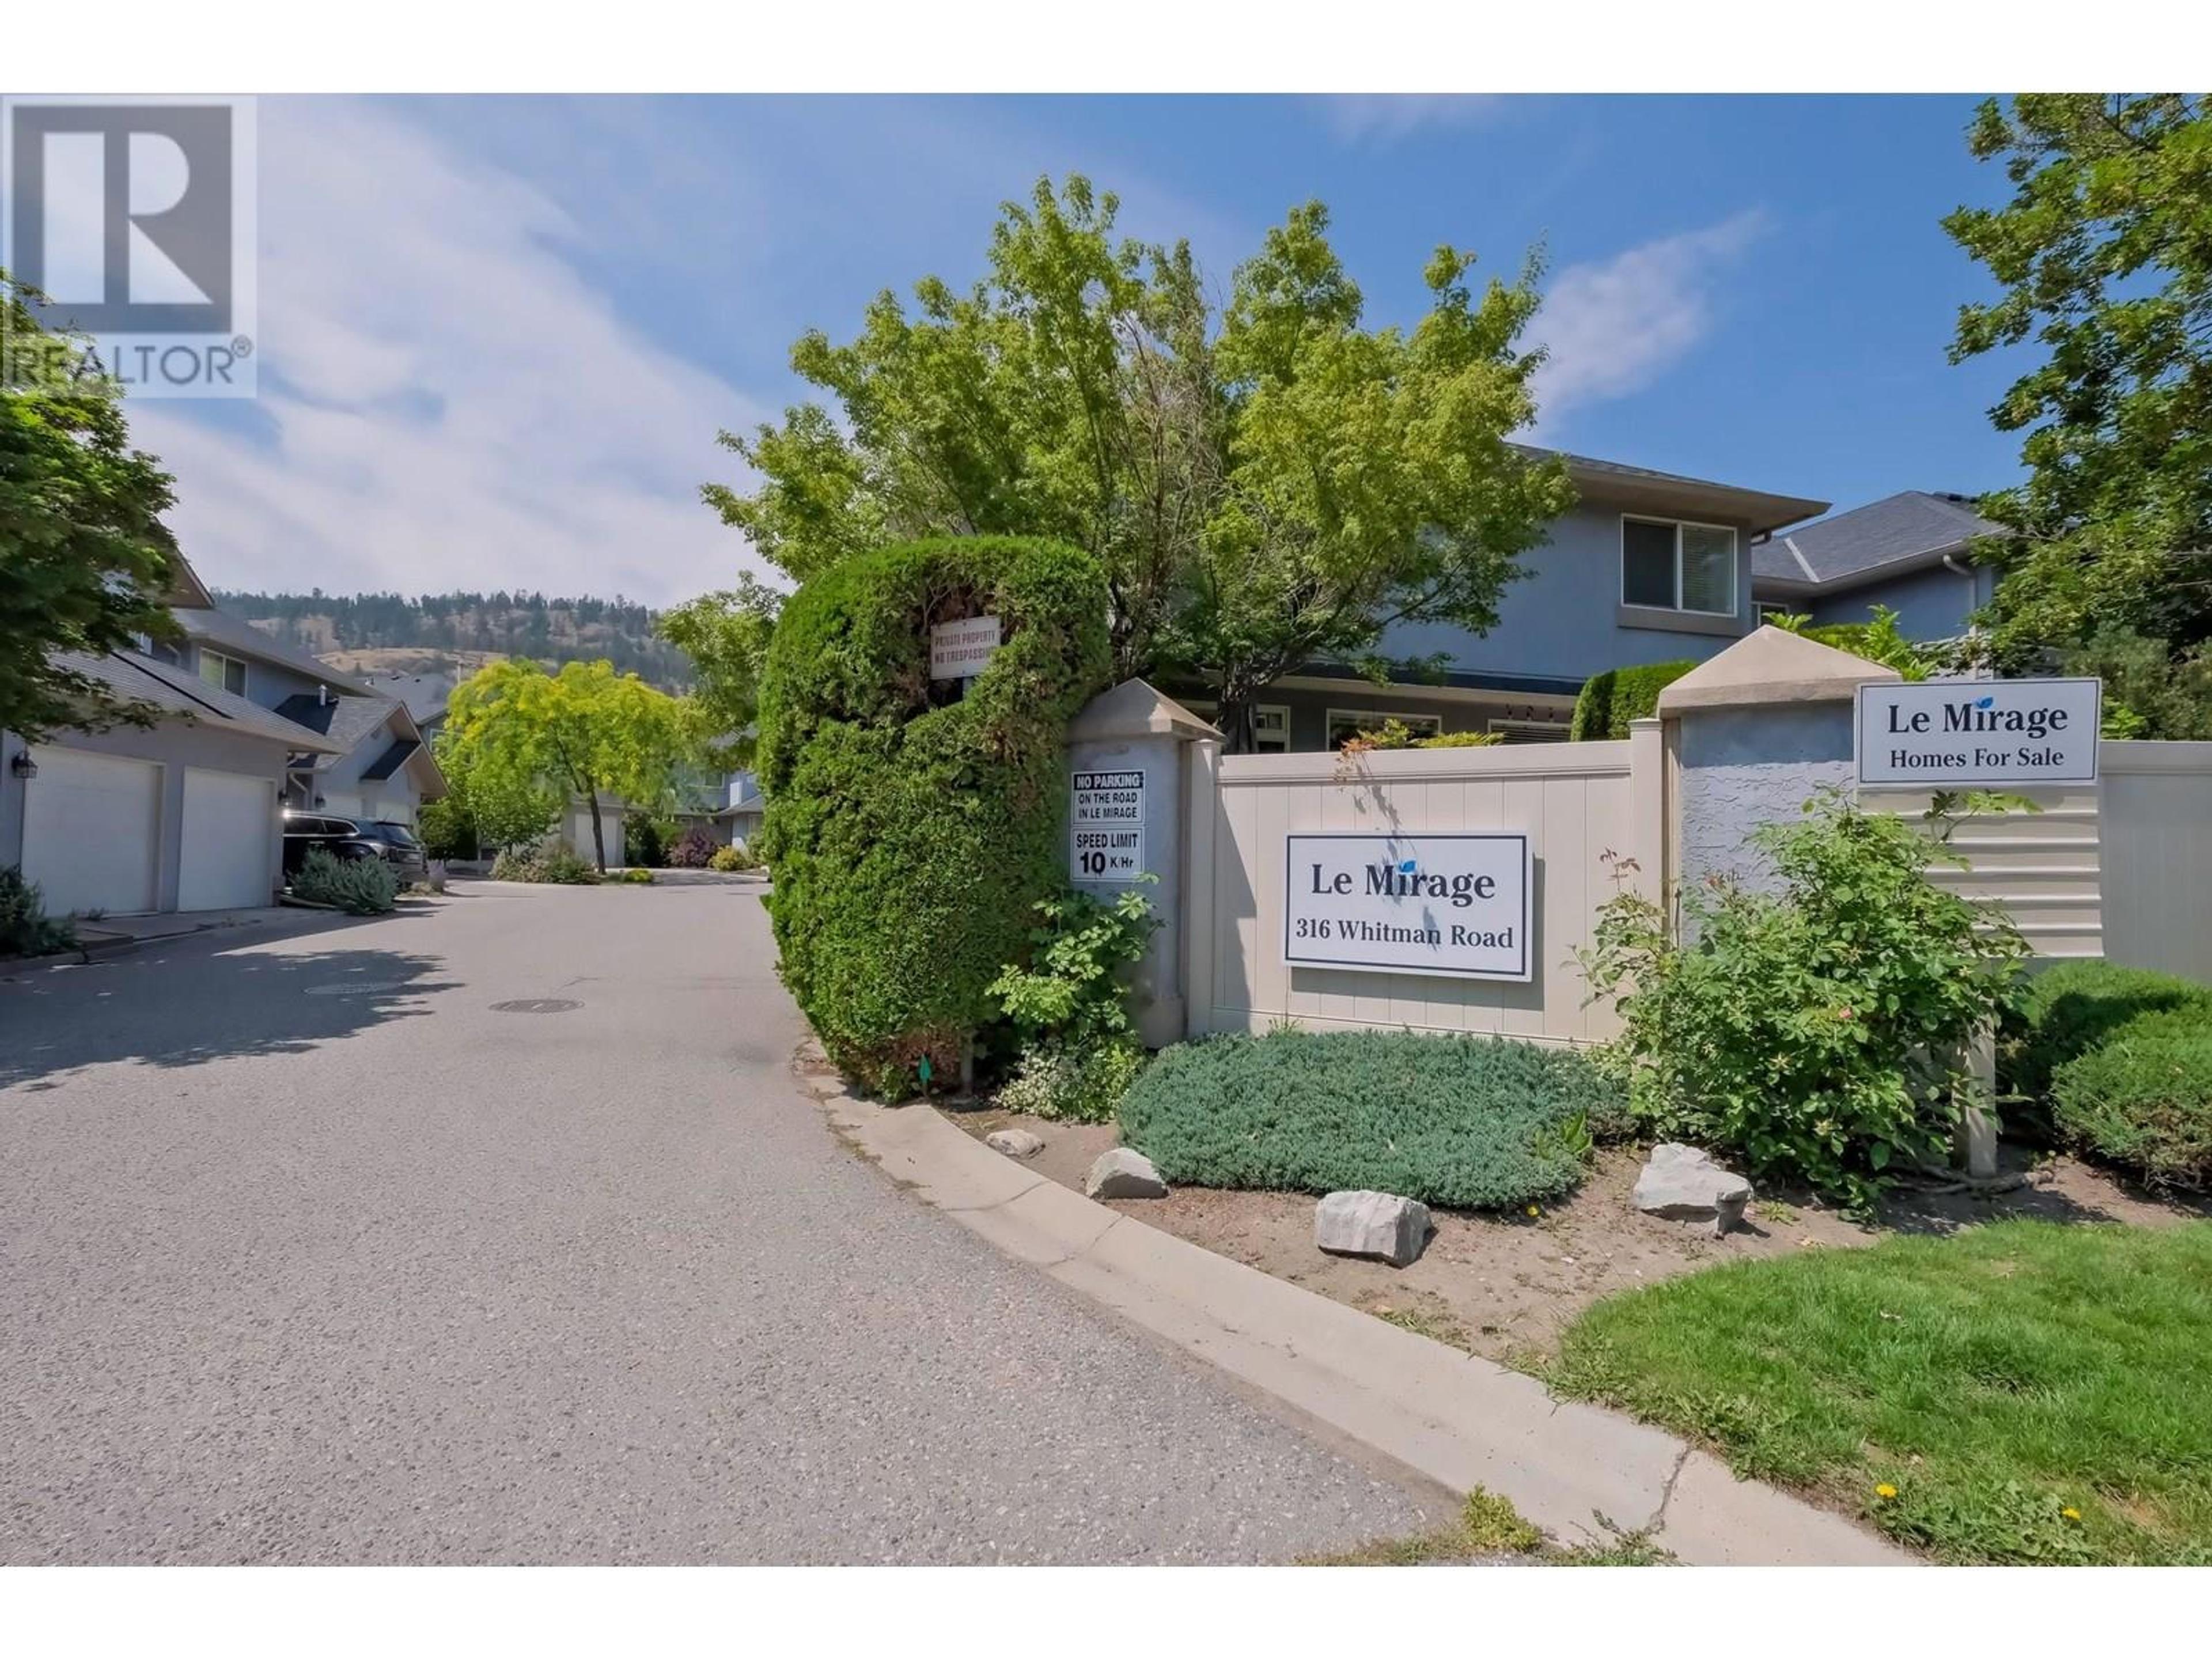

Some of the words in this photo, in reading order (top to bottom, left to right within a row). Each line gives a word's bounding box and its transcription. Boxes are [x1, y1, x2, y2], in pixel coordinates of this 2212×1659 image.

[1888, 704, 1930, 733] Le
[1943, 696, 2068, 739] Mirage
[1891, 749, 1967, 768] Homes
[1974, 748, 2010, 767] For
[2017, 747, 2064, 766] Sale
[1077, 775, 1092, 789] NO
[1094, 774, 1140, 788] PARKING
[1078, 793, 1090, 804] ON
[1094, 793, 1110, 804] THE
[1112, 792, 1138, 803] ROAD
[1078, 809, 1088, 819] IN
[1090, 808, 1100, 818] LE
[1103, 807, 1138, 818] MIRAGE
[1076, 834, 1108, 848] SPEED
[1111, 834, 1138, 847] LIMIT
[1080, 851, 1106, 874] 10
[1311, 863, 1353, 895] Le
[1365, 860, 1496, 908] Mirage
[1296, 918, 1331, 940] 316
[1338, 920, 1441, 945] Whitman
[1450, 925, 1514, 949] Road
